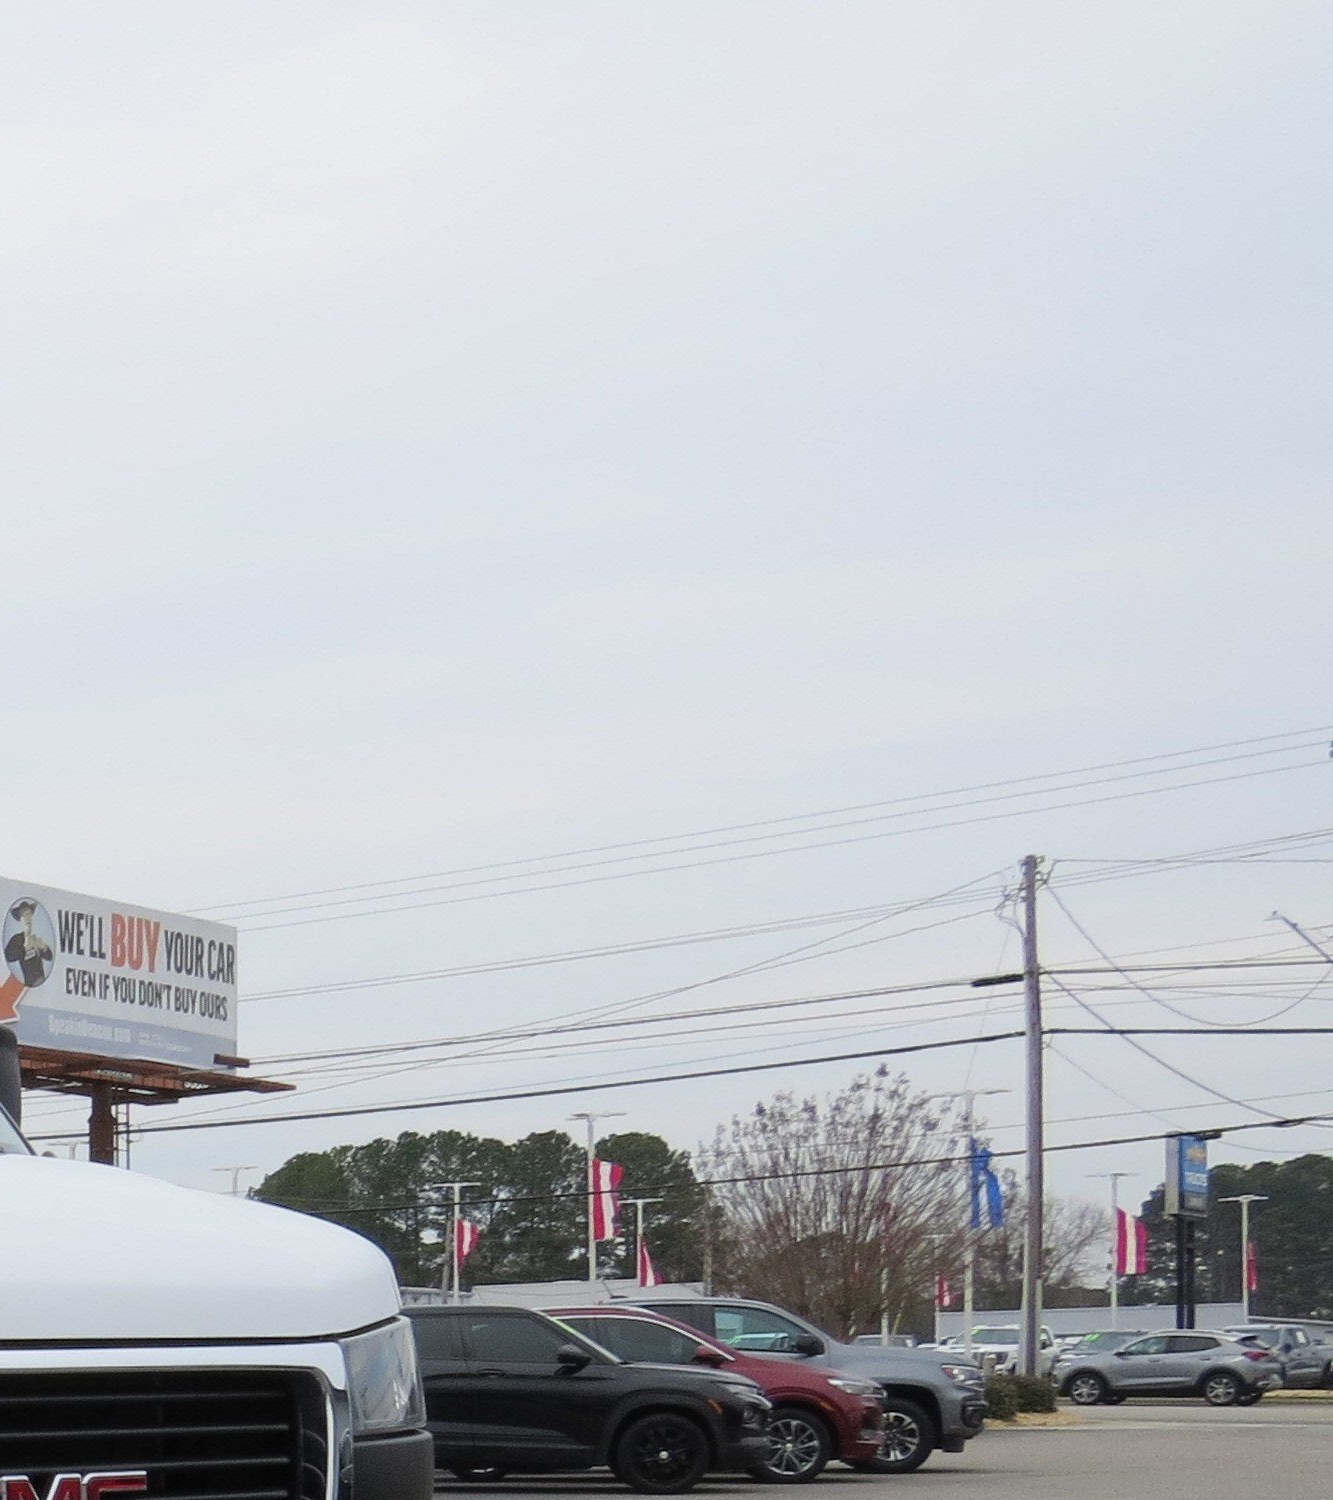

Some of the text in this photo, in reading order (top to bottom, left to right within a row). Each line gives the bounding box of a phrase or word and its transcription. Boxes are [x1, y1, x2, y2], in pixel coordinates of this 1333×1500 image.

[58, 909, 236, 985] WE'LL BUY YOUR CAR
[66, 967, 228, 1021] EVEN IF YOU DON'T BUY OURS
